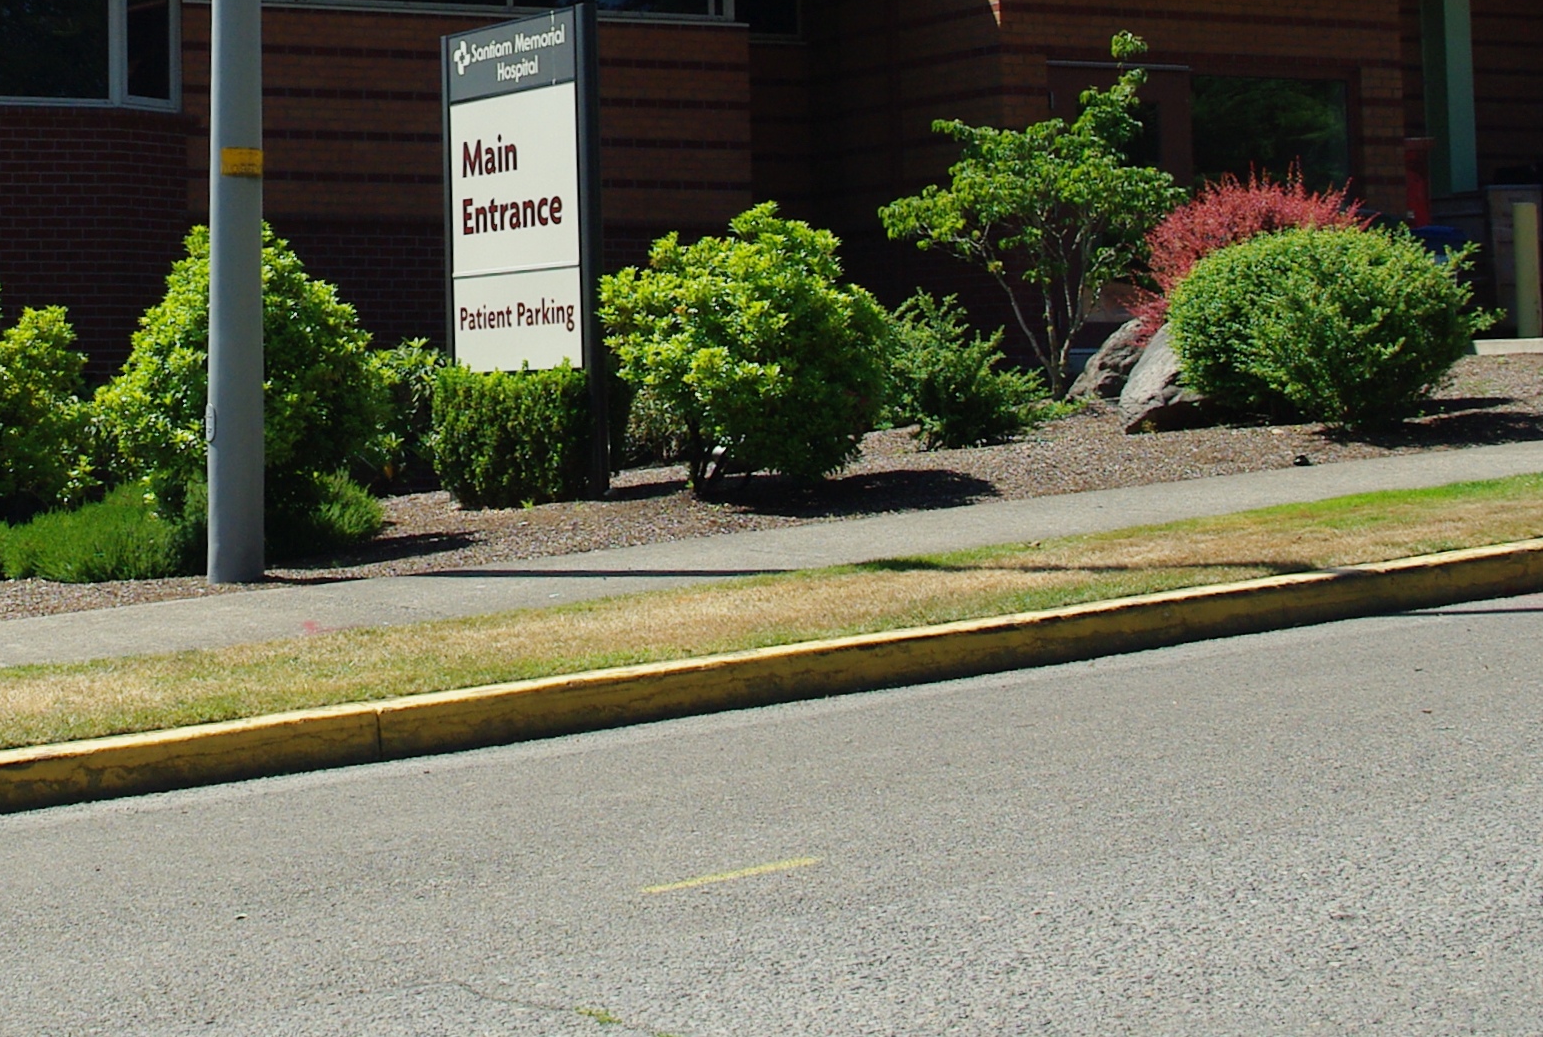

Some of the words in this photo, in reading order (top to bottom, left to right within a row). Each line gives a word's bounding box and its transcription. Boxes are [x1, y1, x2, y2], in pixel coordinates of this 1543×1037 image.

[470, 40, 514, 63] Santiam
[514, 23, 566, 54] Memorial
[496, 56, 539, 84] Hospital
[462, 134, 518, 178] Main
[462, 195, 563, 236] Entrance
[460, 305, 513, 331] Patient
[516, 298, 575, 332] Parking
